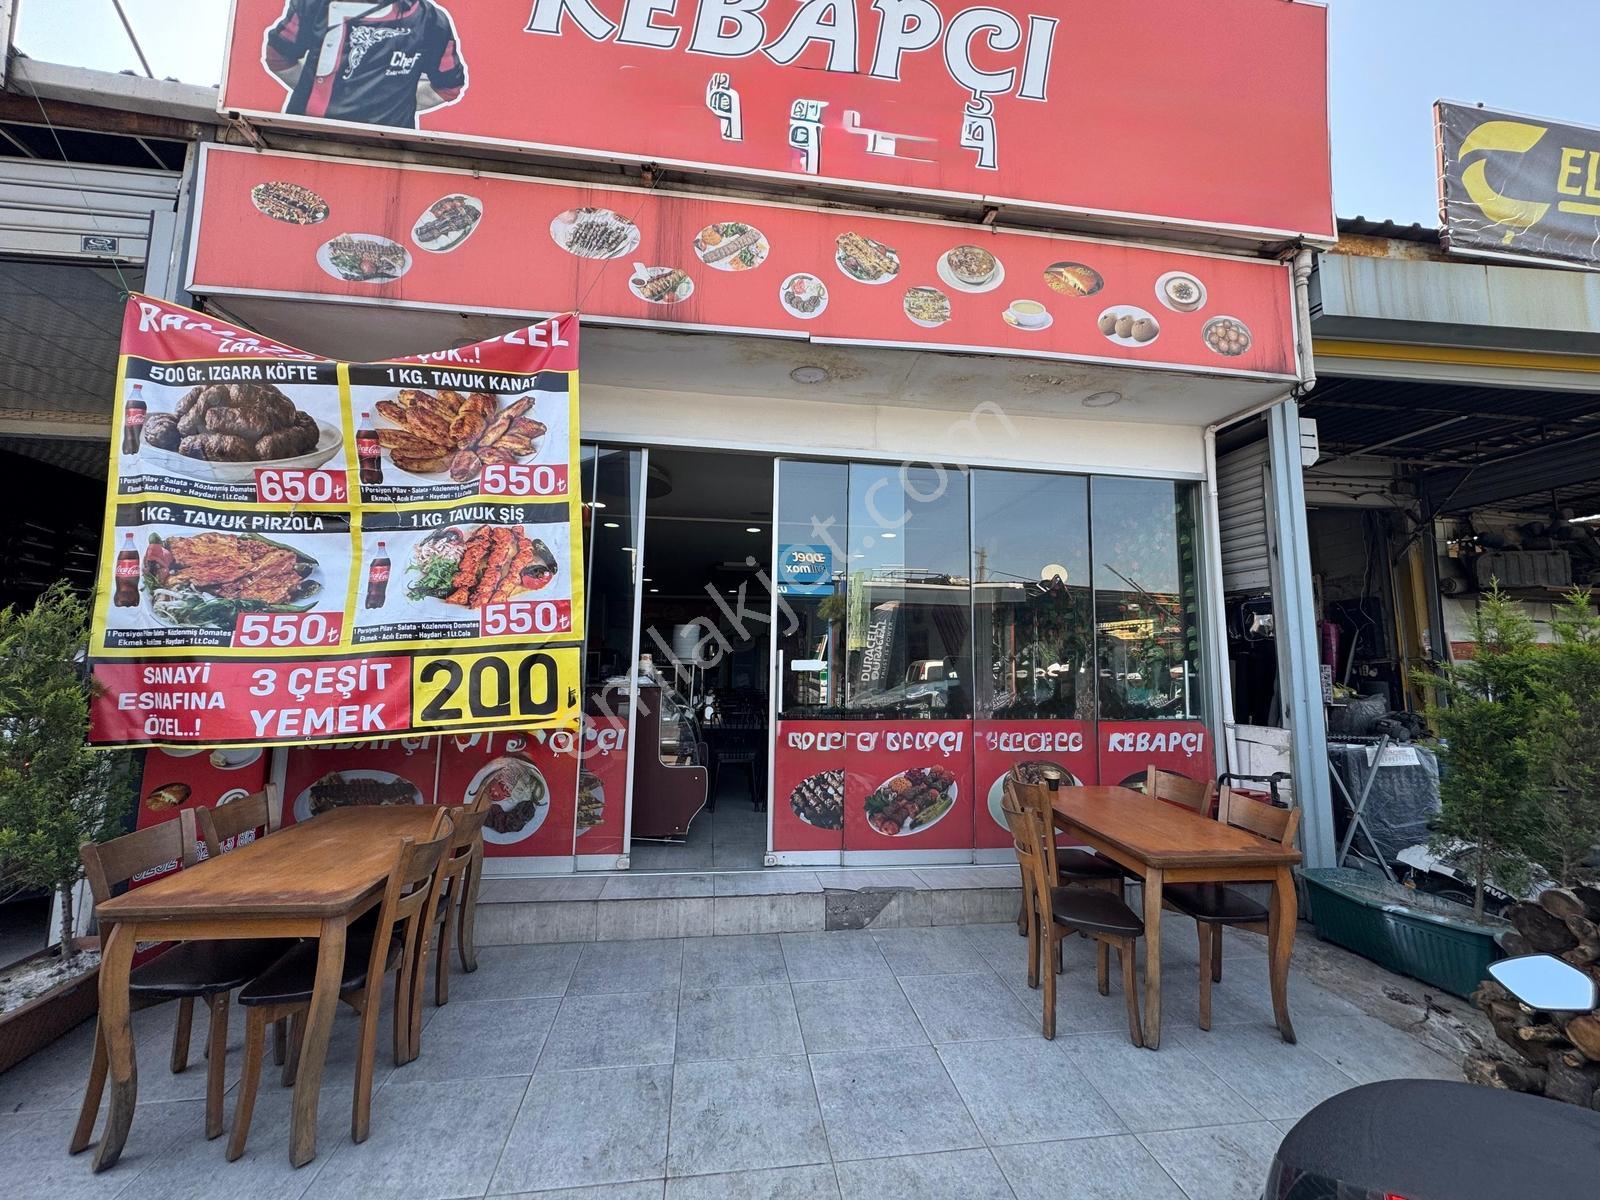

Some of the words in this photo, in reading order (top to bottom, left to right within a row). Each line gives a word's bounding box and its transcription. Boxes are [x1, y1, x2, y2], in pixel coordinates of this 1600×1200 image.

[390, 51, 421, 68] Chef
[484, 320, 569, 347] ZEL
[150, 366, 184, 382] 500
[187, 368, 205, 382] Gr.
[208, 366, 265, 380] IZGARA
[267, 363, 317, 380] KÖFTE
[387, 369, 395, 382] 1
[399, 369, 427, 385] KG.
[431, 371, 485, 388] TAVUK
[489, 375, 537, 391] KANAT
[160, 485, 181, 493] Ezme
[164, 477, 188, 486] Salata
[183, 510, 246, 529] TAVUK
[252, 514, 324, 531] PİRZOLA
[411, 514, 417, 526] 1
[421, 513, 445, 526] KG.
[449, 507, 496, 522] TAVUK
[500, 506, 524, 523] ŞİŞ
[199, 629, 231, 637] Domates
[861, 622, 879, 681] DURACELL
[143, 663, 211, 684] SANAYİ
[249, 669, 277, 696] 3
[288, 659, 392, 701] ÇEŞİT
[118, 692, 225, 710] ESNAFINA
[250, 704, 386, 737] YEMEK
[1108, 732, 1203, 757] KEBAPÇI
